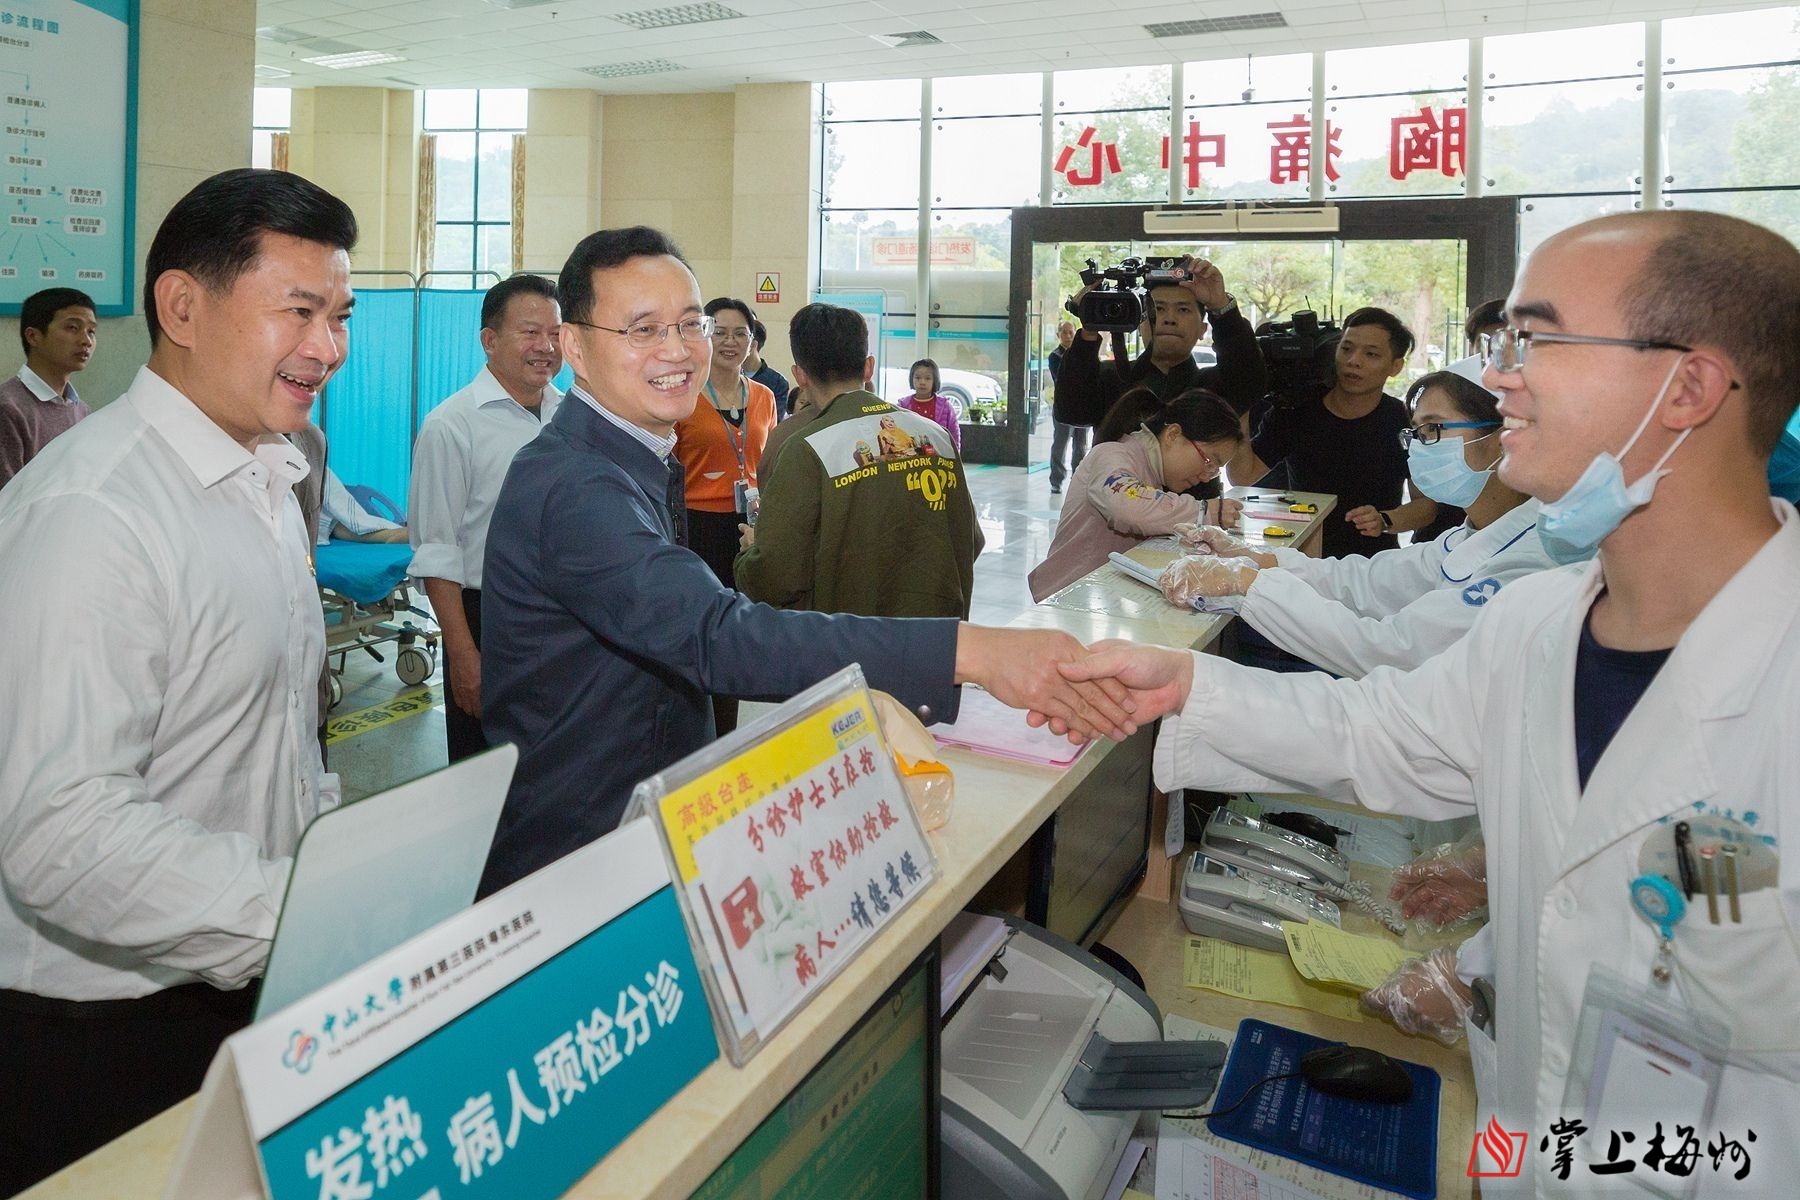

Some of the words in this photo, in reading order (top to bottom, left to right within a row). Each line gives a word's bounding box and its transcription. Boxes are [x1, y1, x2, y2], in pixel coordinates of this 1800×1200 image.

[834, 466, 878, 489] LONDON
[677, 772, 754, 831] 高级台座
[748, 747, 876, 853] 分诊护士正在抢
[790, 799, 899, 900] 救室协助抢救
[305, 1095, 428, 1200] 发热
[447, 960, 683, 1185] 病人预检分诊
